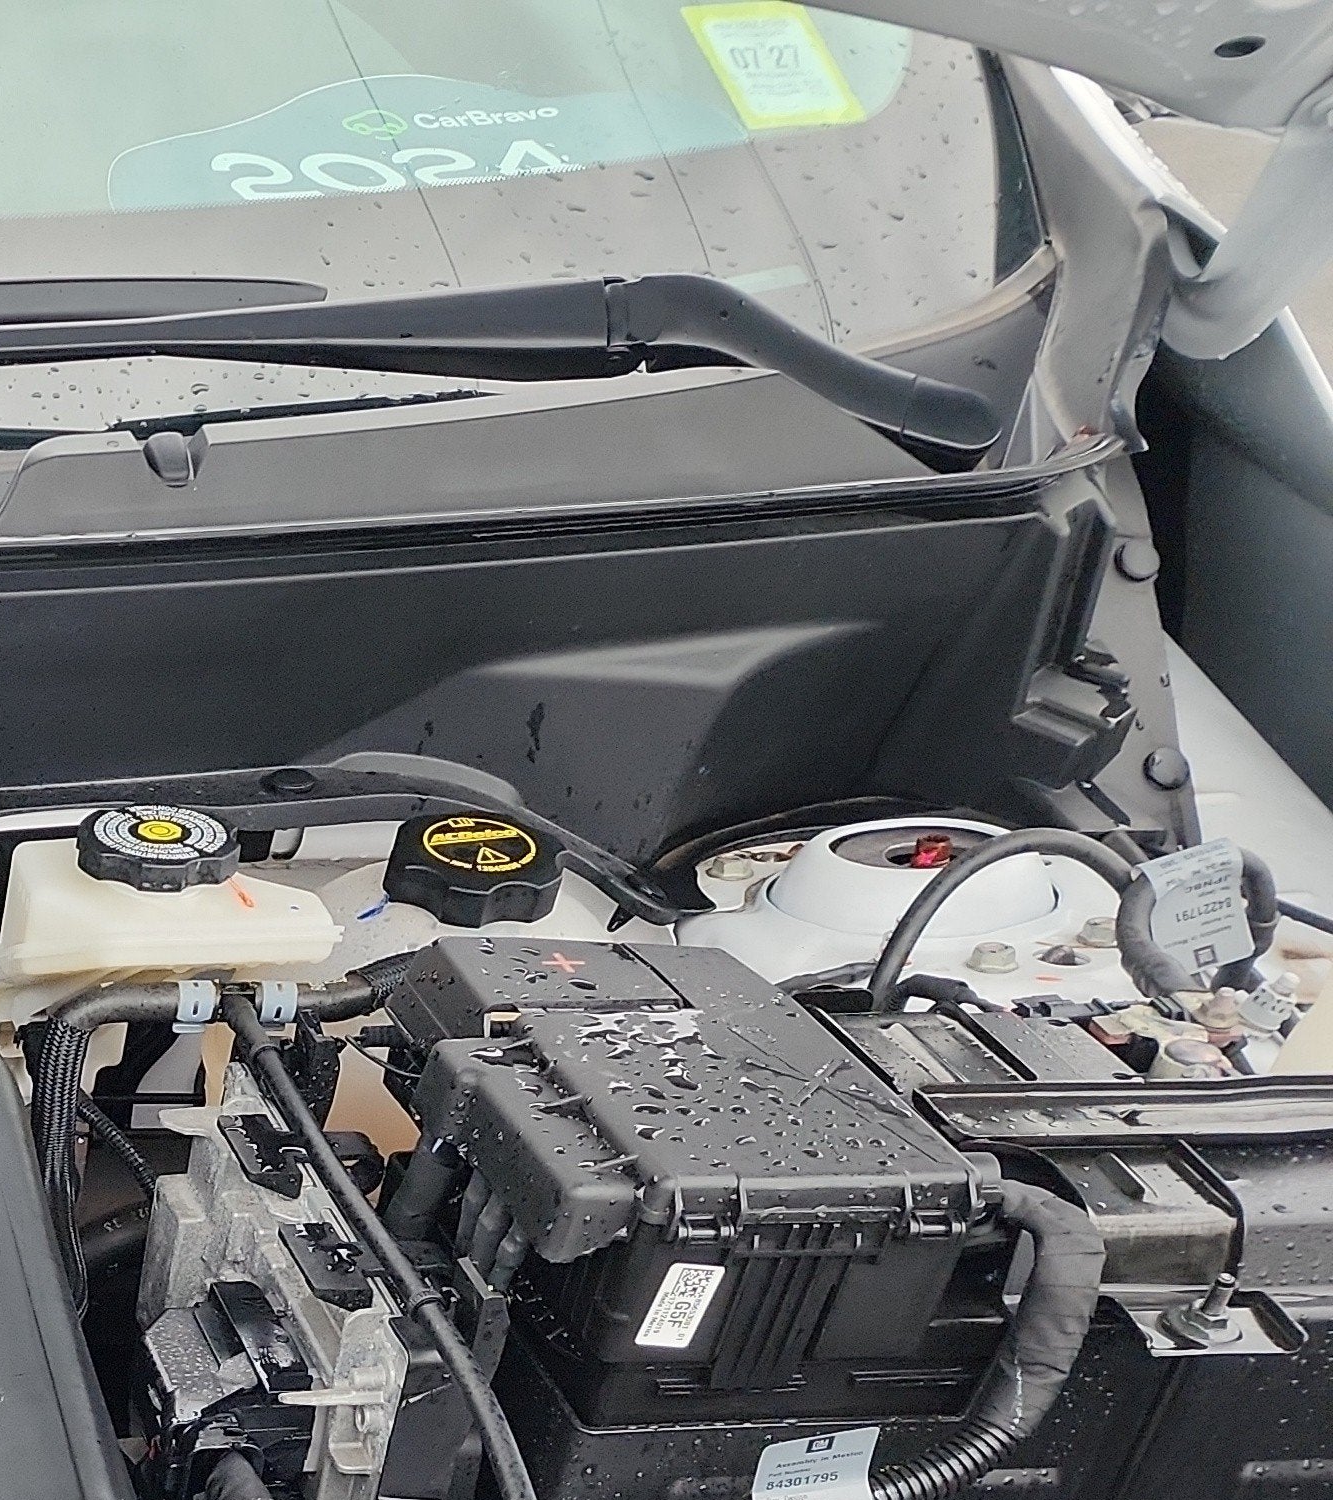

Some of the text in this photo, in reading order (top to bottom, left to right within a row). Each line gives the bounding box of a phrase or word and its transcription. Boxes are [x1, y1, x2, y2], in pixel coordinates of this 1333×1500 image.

[413, 106, 560, 129] CarBravo
[430, 828, 518, 843] ACDelco
[667, 1301, 691, 1328] G5F
[775, 1458, 818, 1469] Assembly
[832, 1450, 864, 1460] Mexico
[765, 1471, 839, 1491] 84301795
